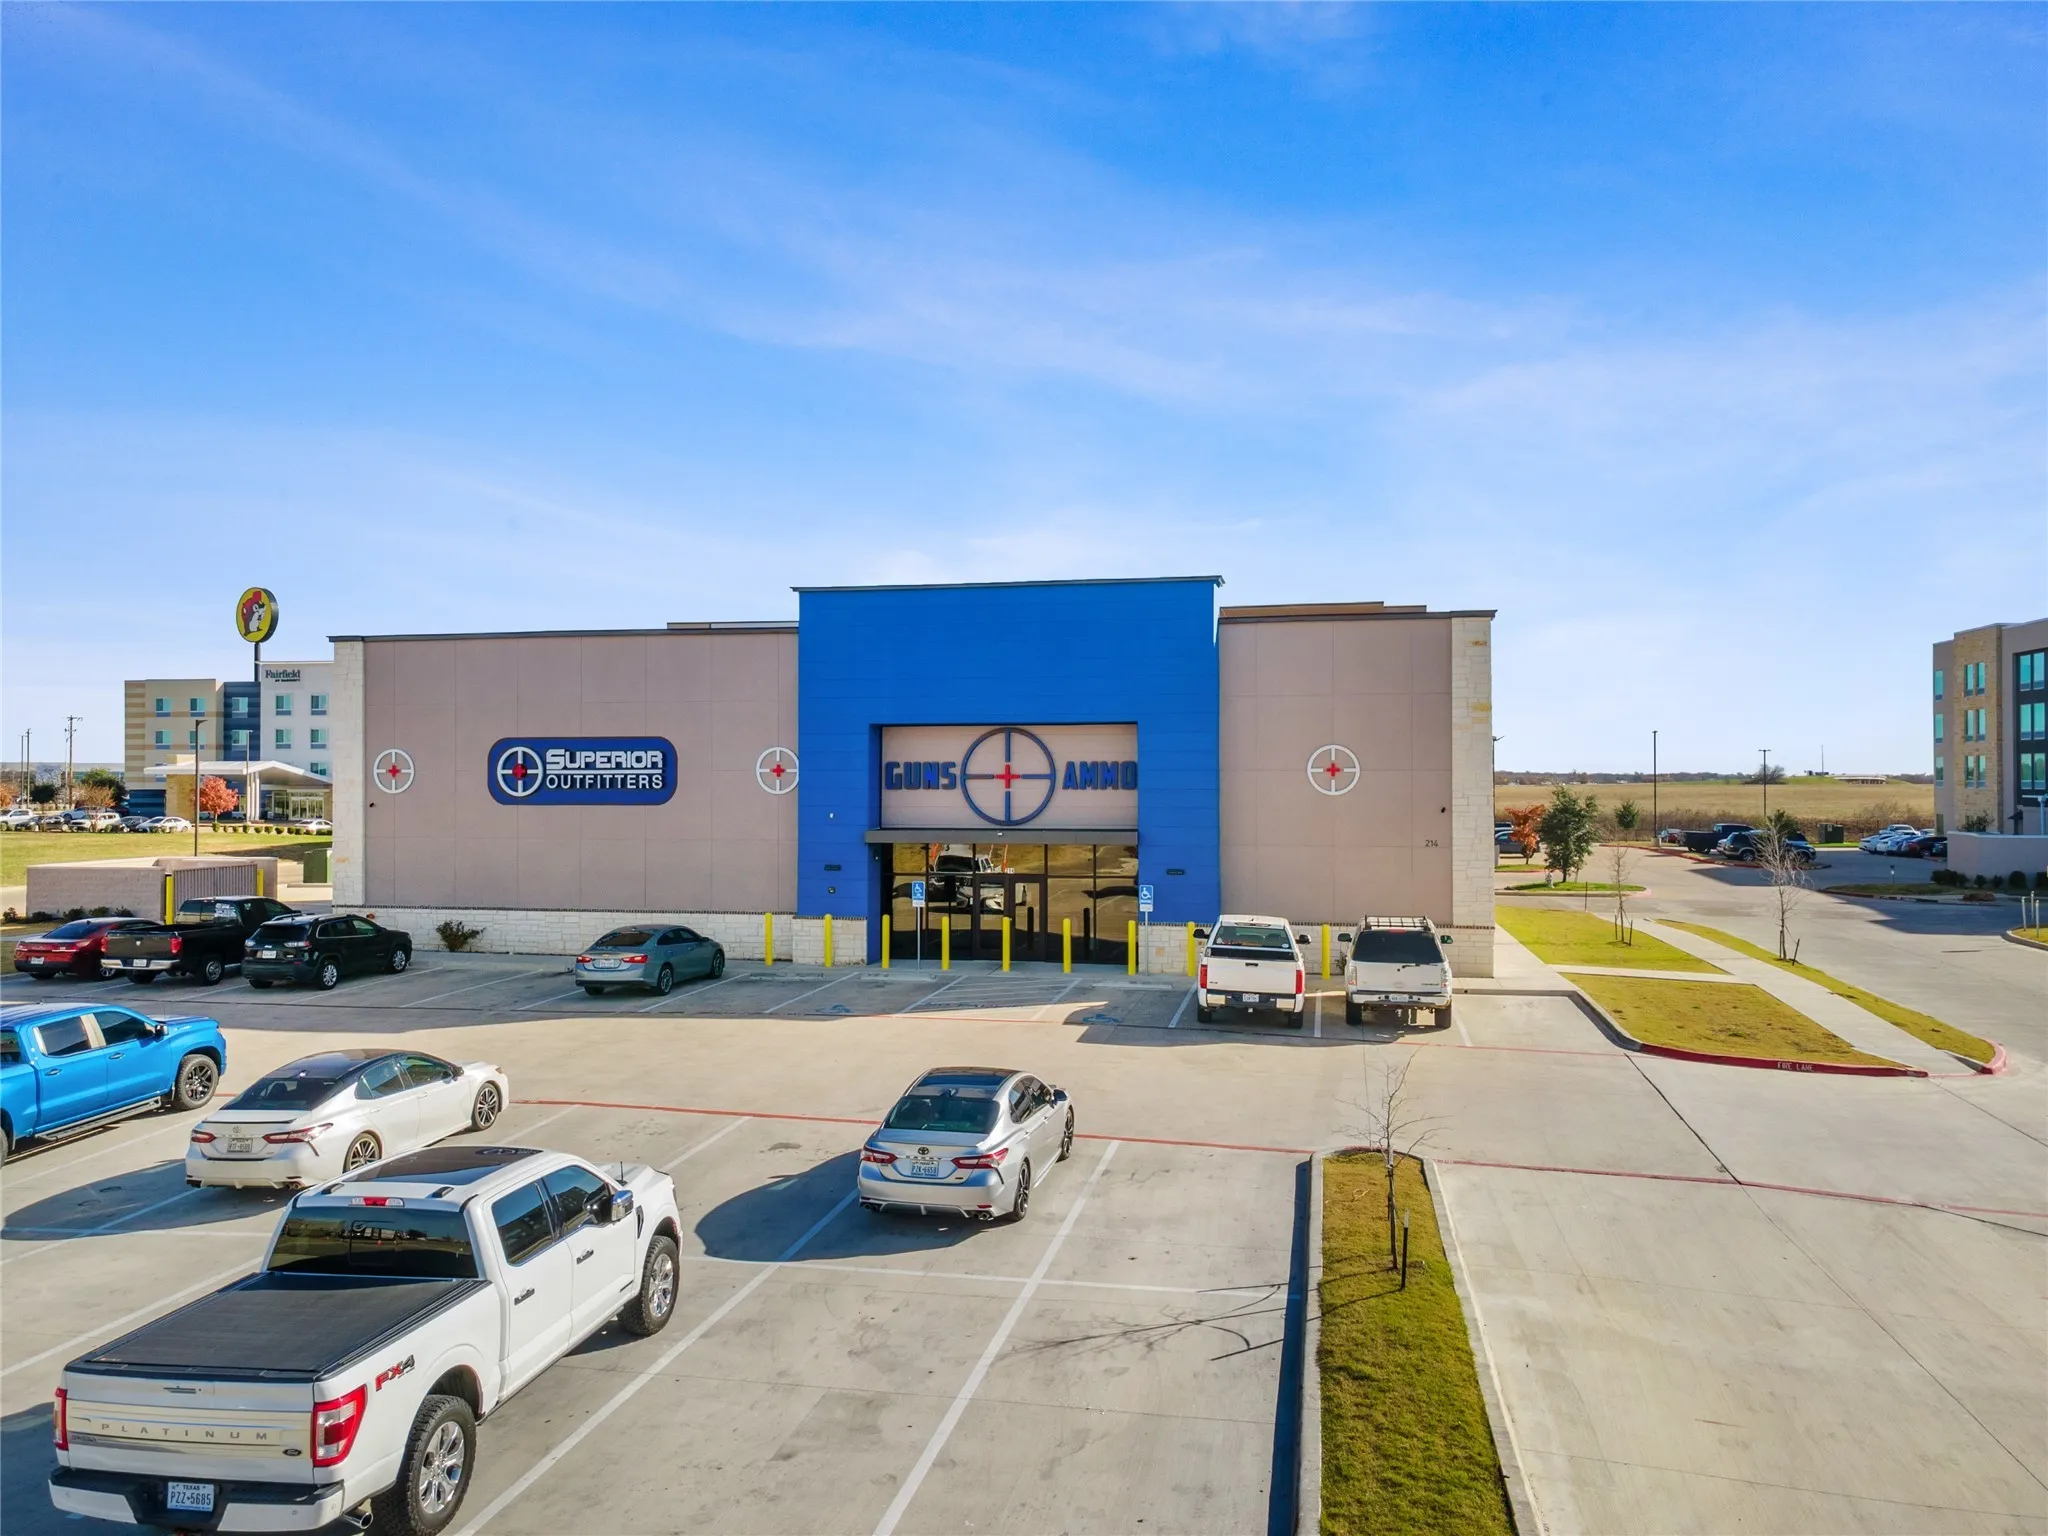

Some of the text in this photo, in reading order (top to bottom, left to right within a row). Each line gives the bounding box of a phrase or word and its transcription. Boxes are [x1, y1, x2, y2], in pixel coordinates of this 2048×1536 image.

[265, 669, 300, 679] Fairfield
[545, 749, 663, 770] SUPERIOR
[546, 774, 663, 789] OUTFITTERS
[884, 761, 957, 790] GUNS
[1062, 760, 1138, 790] AMMO
[1777, 1061, 1815, 1072] FIRE LANE
[375, 1354, 416, 1392] FX4
[101, 1423, 268, 1440] PLATINUM
